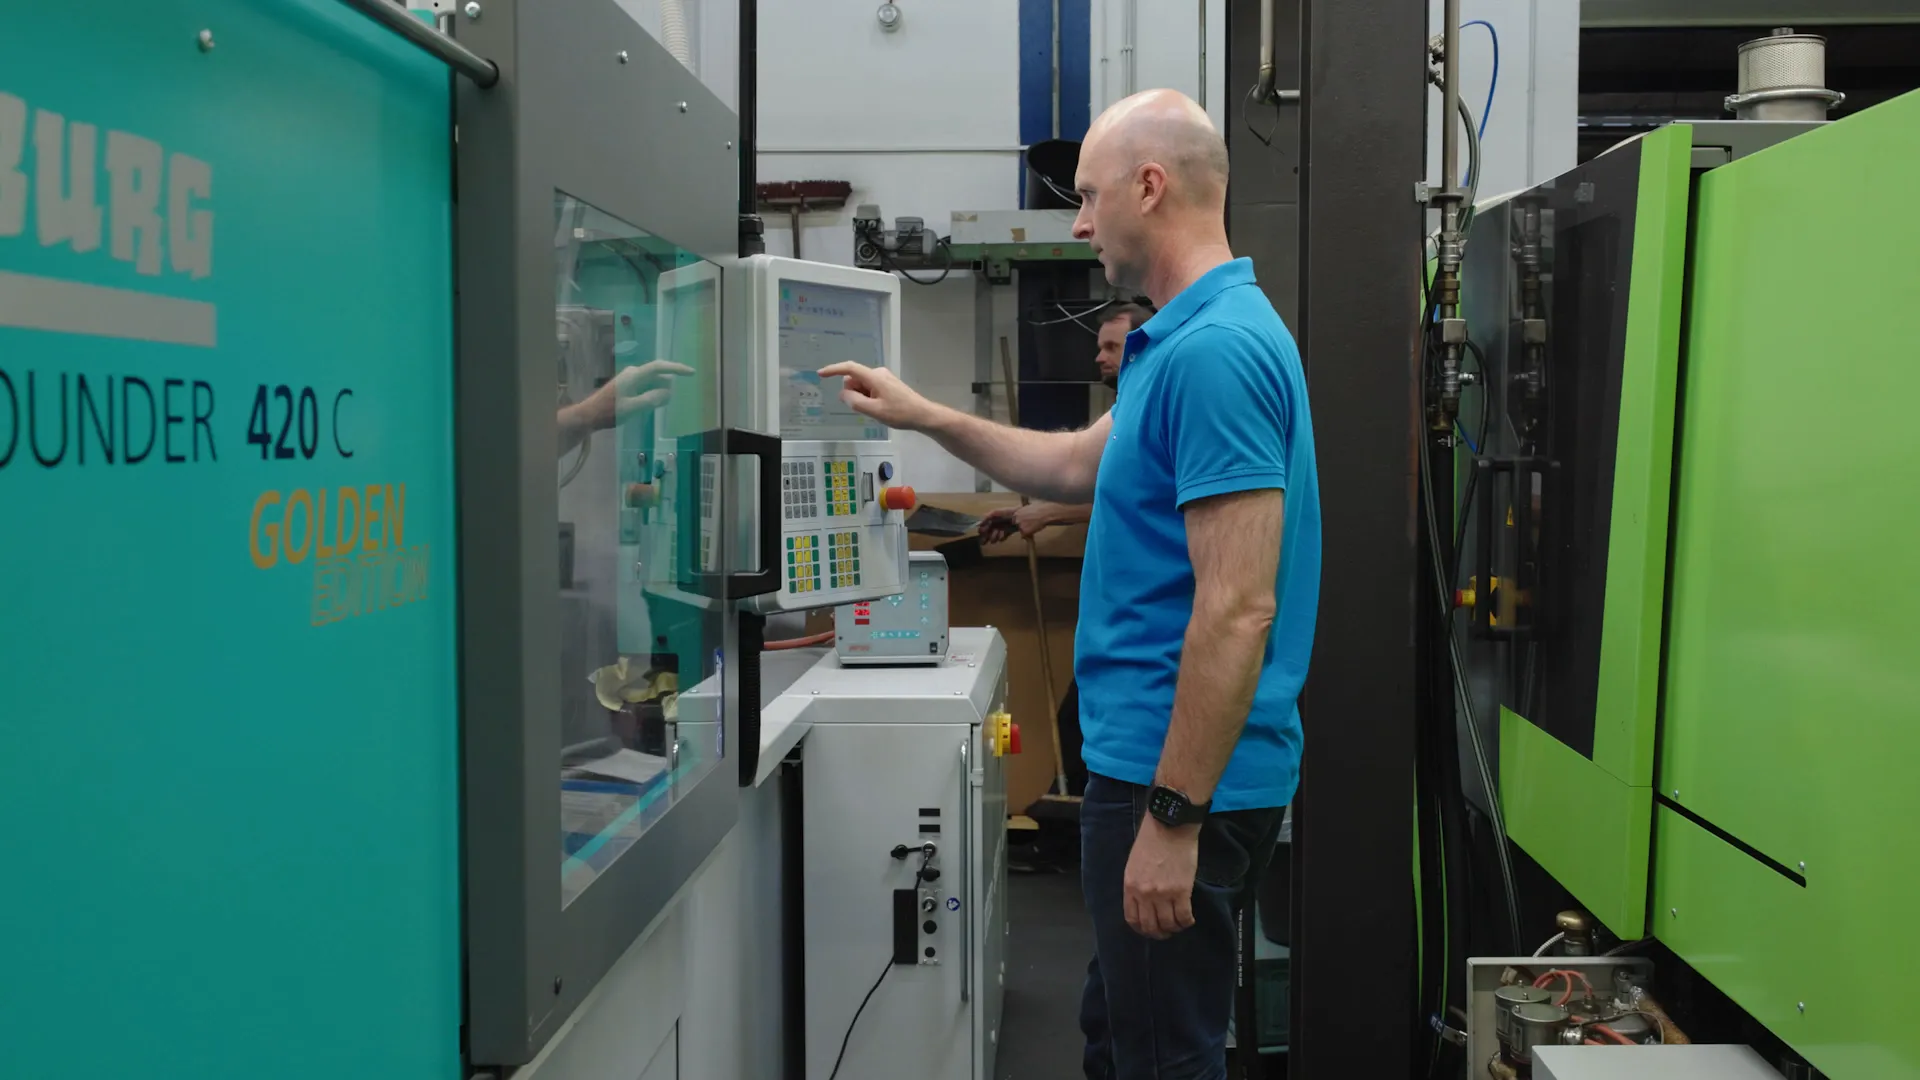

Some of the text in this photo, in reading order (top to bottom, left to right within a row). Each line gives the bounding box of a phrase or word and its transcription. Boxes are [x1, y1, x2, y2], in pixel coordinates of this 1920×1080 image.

[247, 384, 318, 460] 420
[333, 388, 354, 458] C
[249, 482, 406, 570] GOLDEN
[311, 543, 430, 627] EDITION
